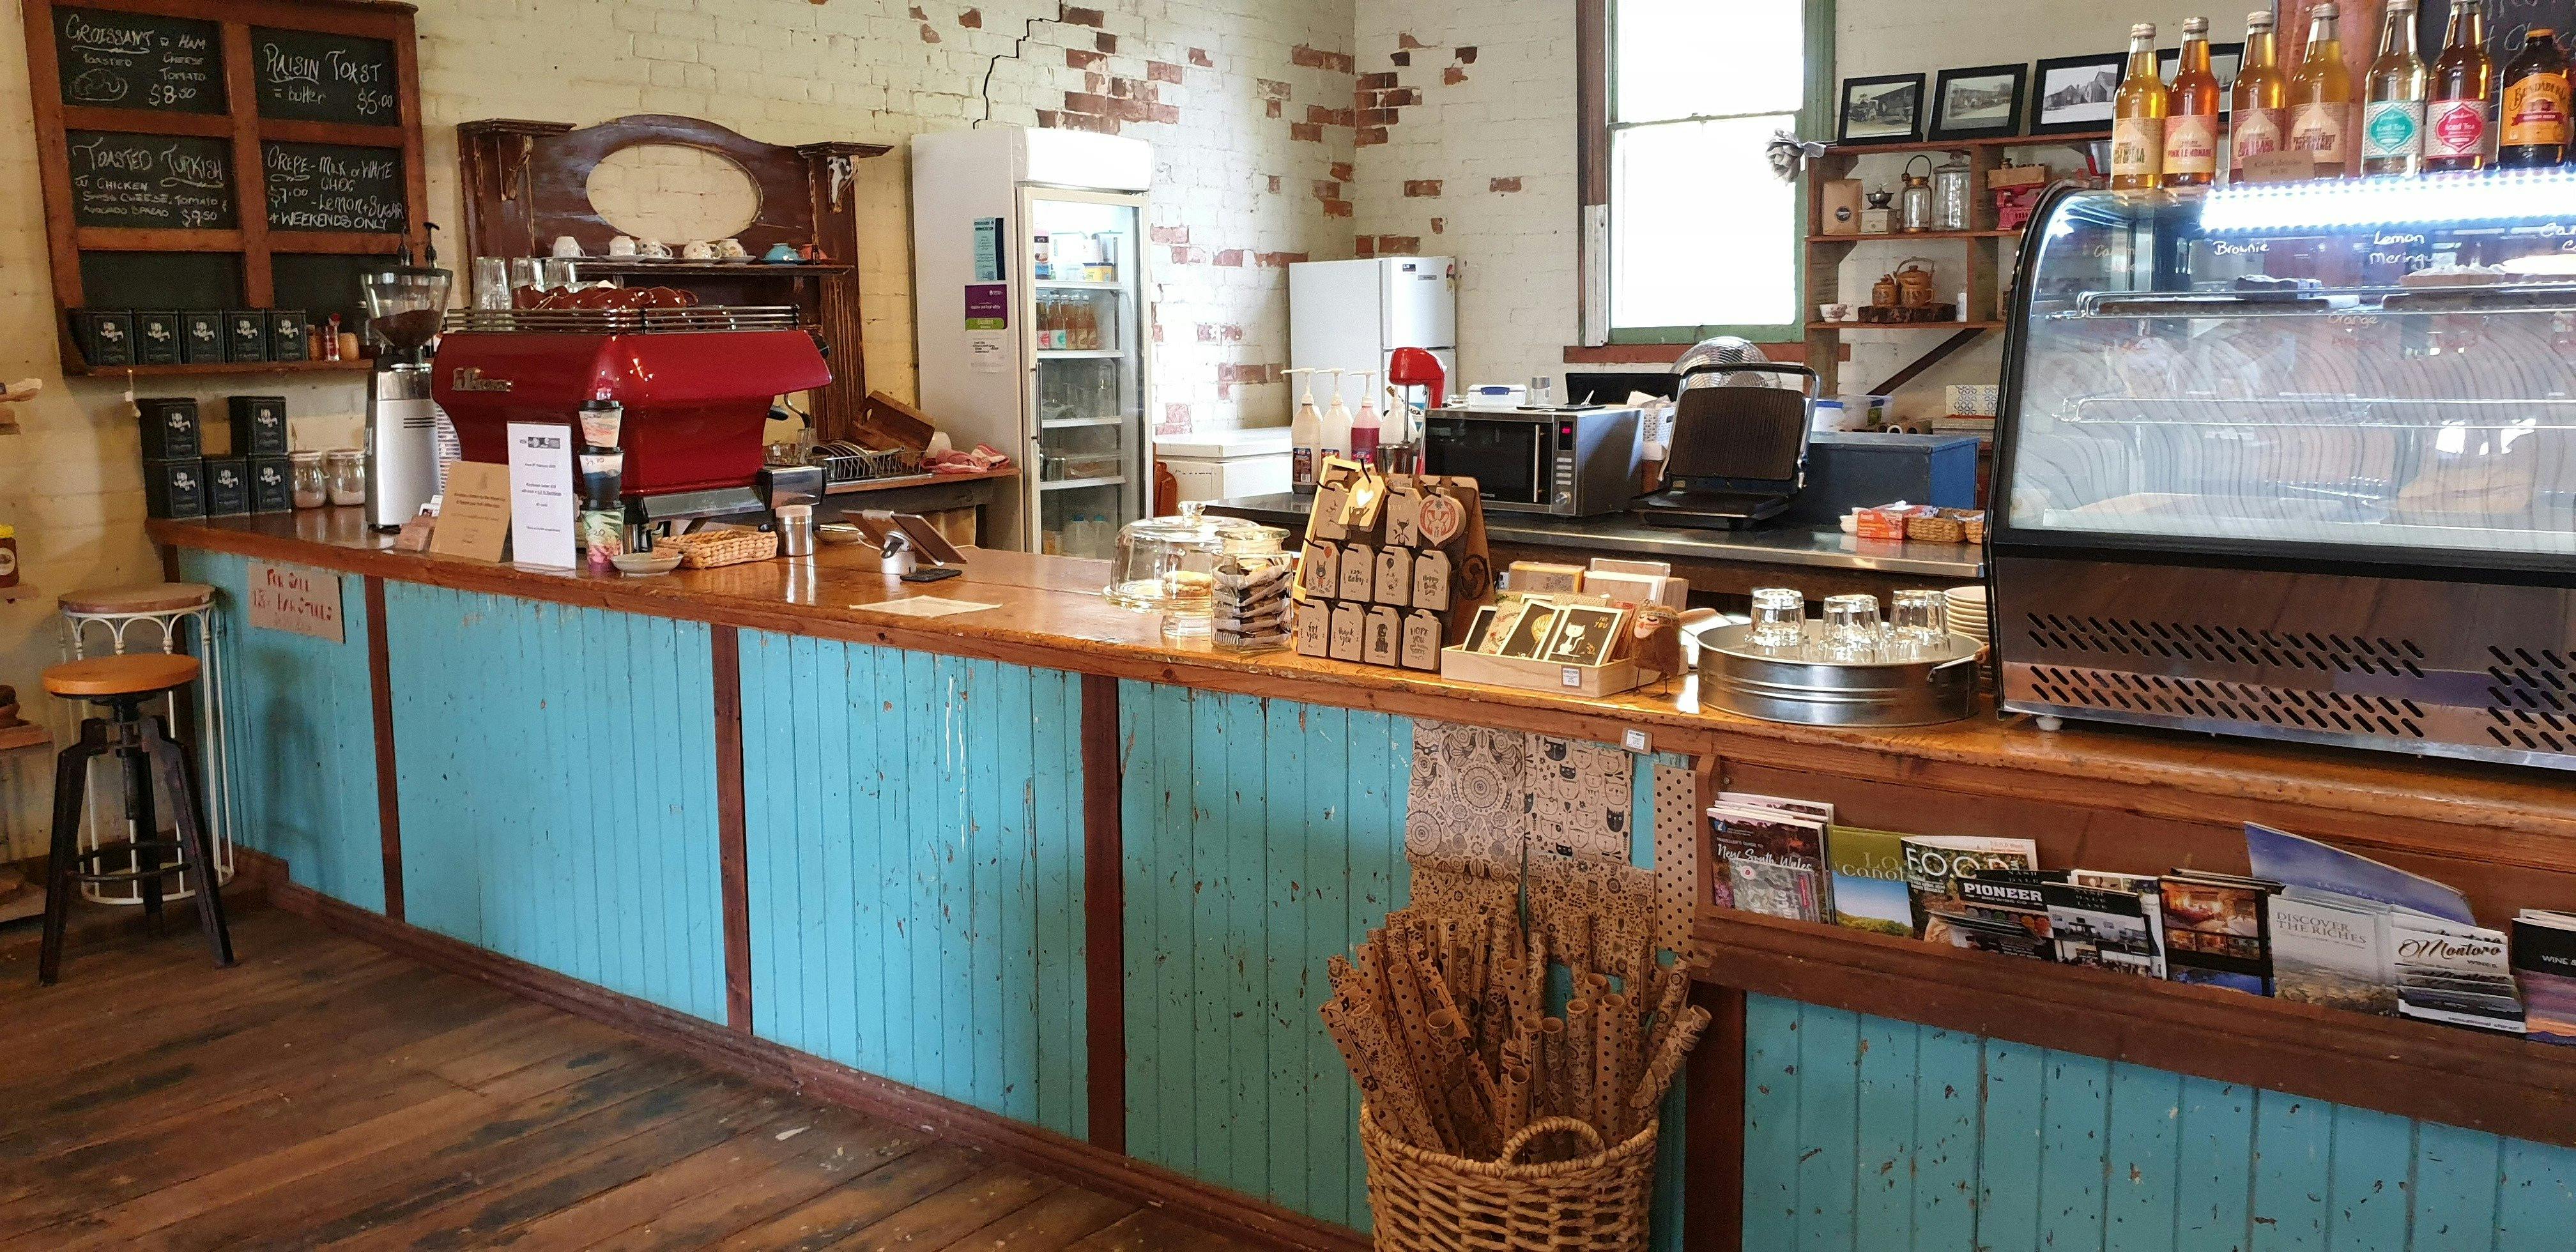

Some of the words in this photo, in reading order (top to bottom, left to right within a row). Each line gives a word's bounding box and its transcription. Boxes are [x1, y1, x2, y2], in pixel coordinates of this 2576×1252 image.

[66, 14, 154, 47] CROISSANT
[178, 34, 206, 49] HAM
[263, 43, 319, 81] RAISIN
[325, 49, 382, 84] TOAST
[288, 86, 326, 104] butter
[357, 88, 393, 115] $5.00
[73, 137, 153, 171] TOASTED
[160, 144, 223, 180] TURKISH
[96, 177, 148, 191] CHICKEN
[321, 178, 356, 192] CHOC
[181, 208, 217, 227] $9.50
[282, 211, 351, 228] WEEKENDS
[353, 217, 387, 231] ONLY
[2212, 240, 2269, 256] Brownie
[2373, 231, 2425, 245] Lemon
[1717, 843, 1741, 860] New
[1745, 848, 1774, 864] South
[1781, 855, 1813, 871] Wales
[1963, 882, 2043, 902] PIONEER
[2277, 912, 2349, 932] DISCOVER
[2277, 920, 2308, 933] THE
[2312, 926, 2366, 943] RICHES
[2542, 954, 2568, 965] WINE
